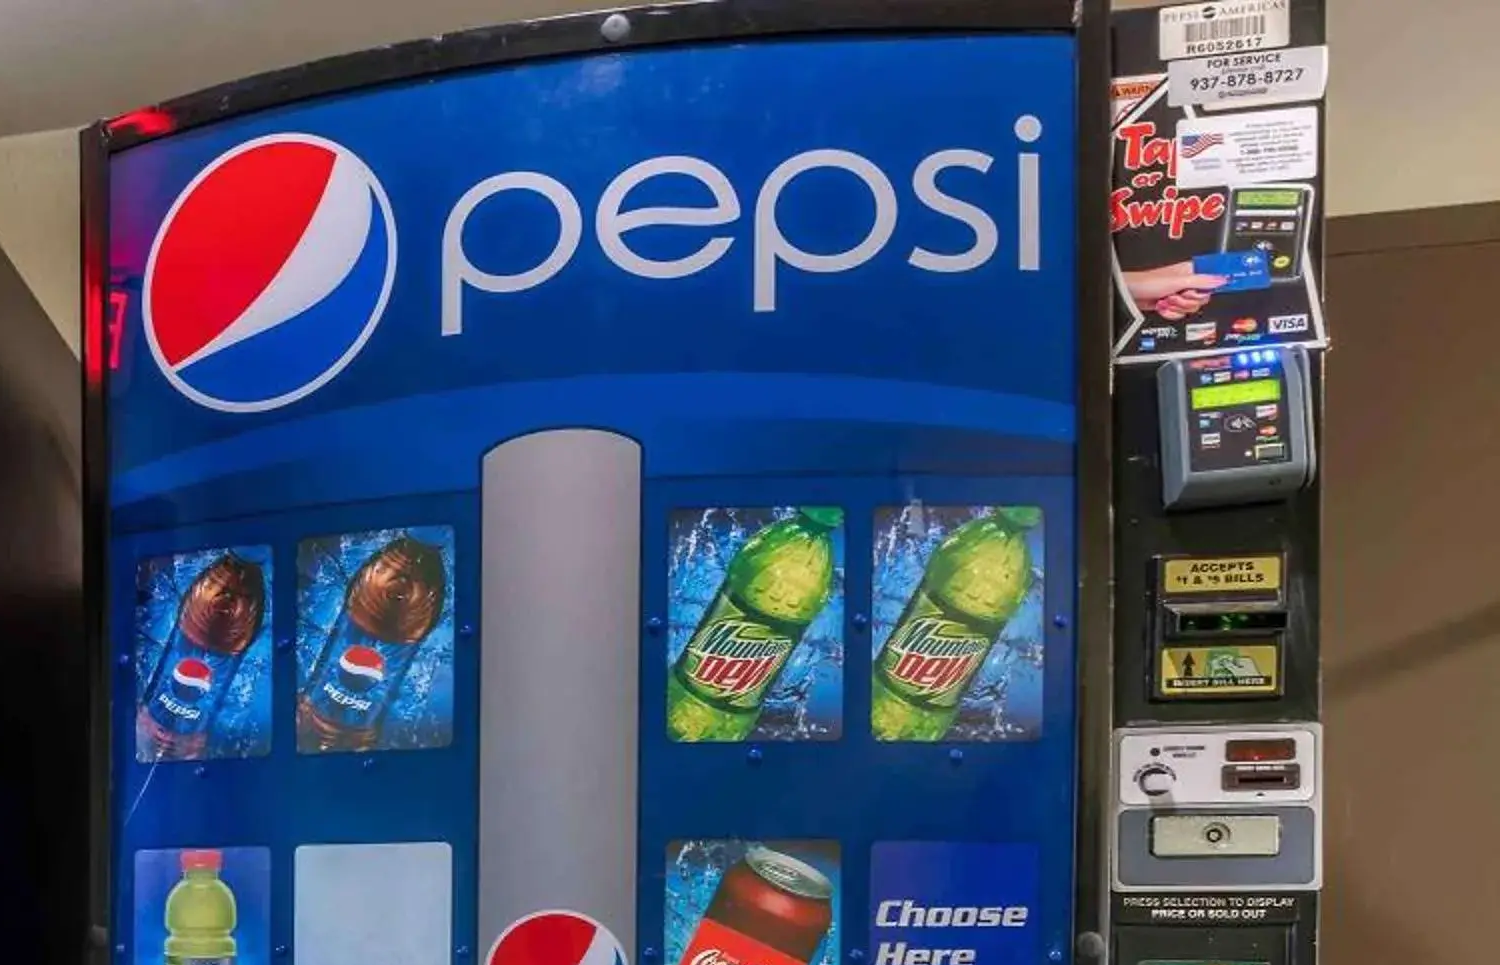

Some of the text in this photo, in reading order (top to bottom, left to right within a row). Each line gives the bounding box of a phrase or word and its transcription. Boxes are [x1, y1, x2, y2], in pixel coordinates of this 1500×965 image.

[1206, 53, 1282, 69] FOR SERVICE
[1189, 68, 1305, 91] 937-878-8727
[1132, 172, 1164, 188] or
[1110, 186, 1226, 239] Swipe
[441, 114, 1042, 337] pepsi
[1271, 317, 1307, 331] VISA
[1190, 561, 1255, 574] ACCEPTS
[1224, 573, 1265, 583] BILLS
[1123, 898, 1295, 908] PRESS SELECTION TO DISPLAY
[875, 899, 1029, 928] Choose
[1151, 908, 1267, 919] PRICE OR SOLD OUT
